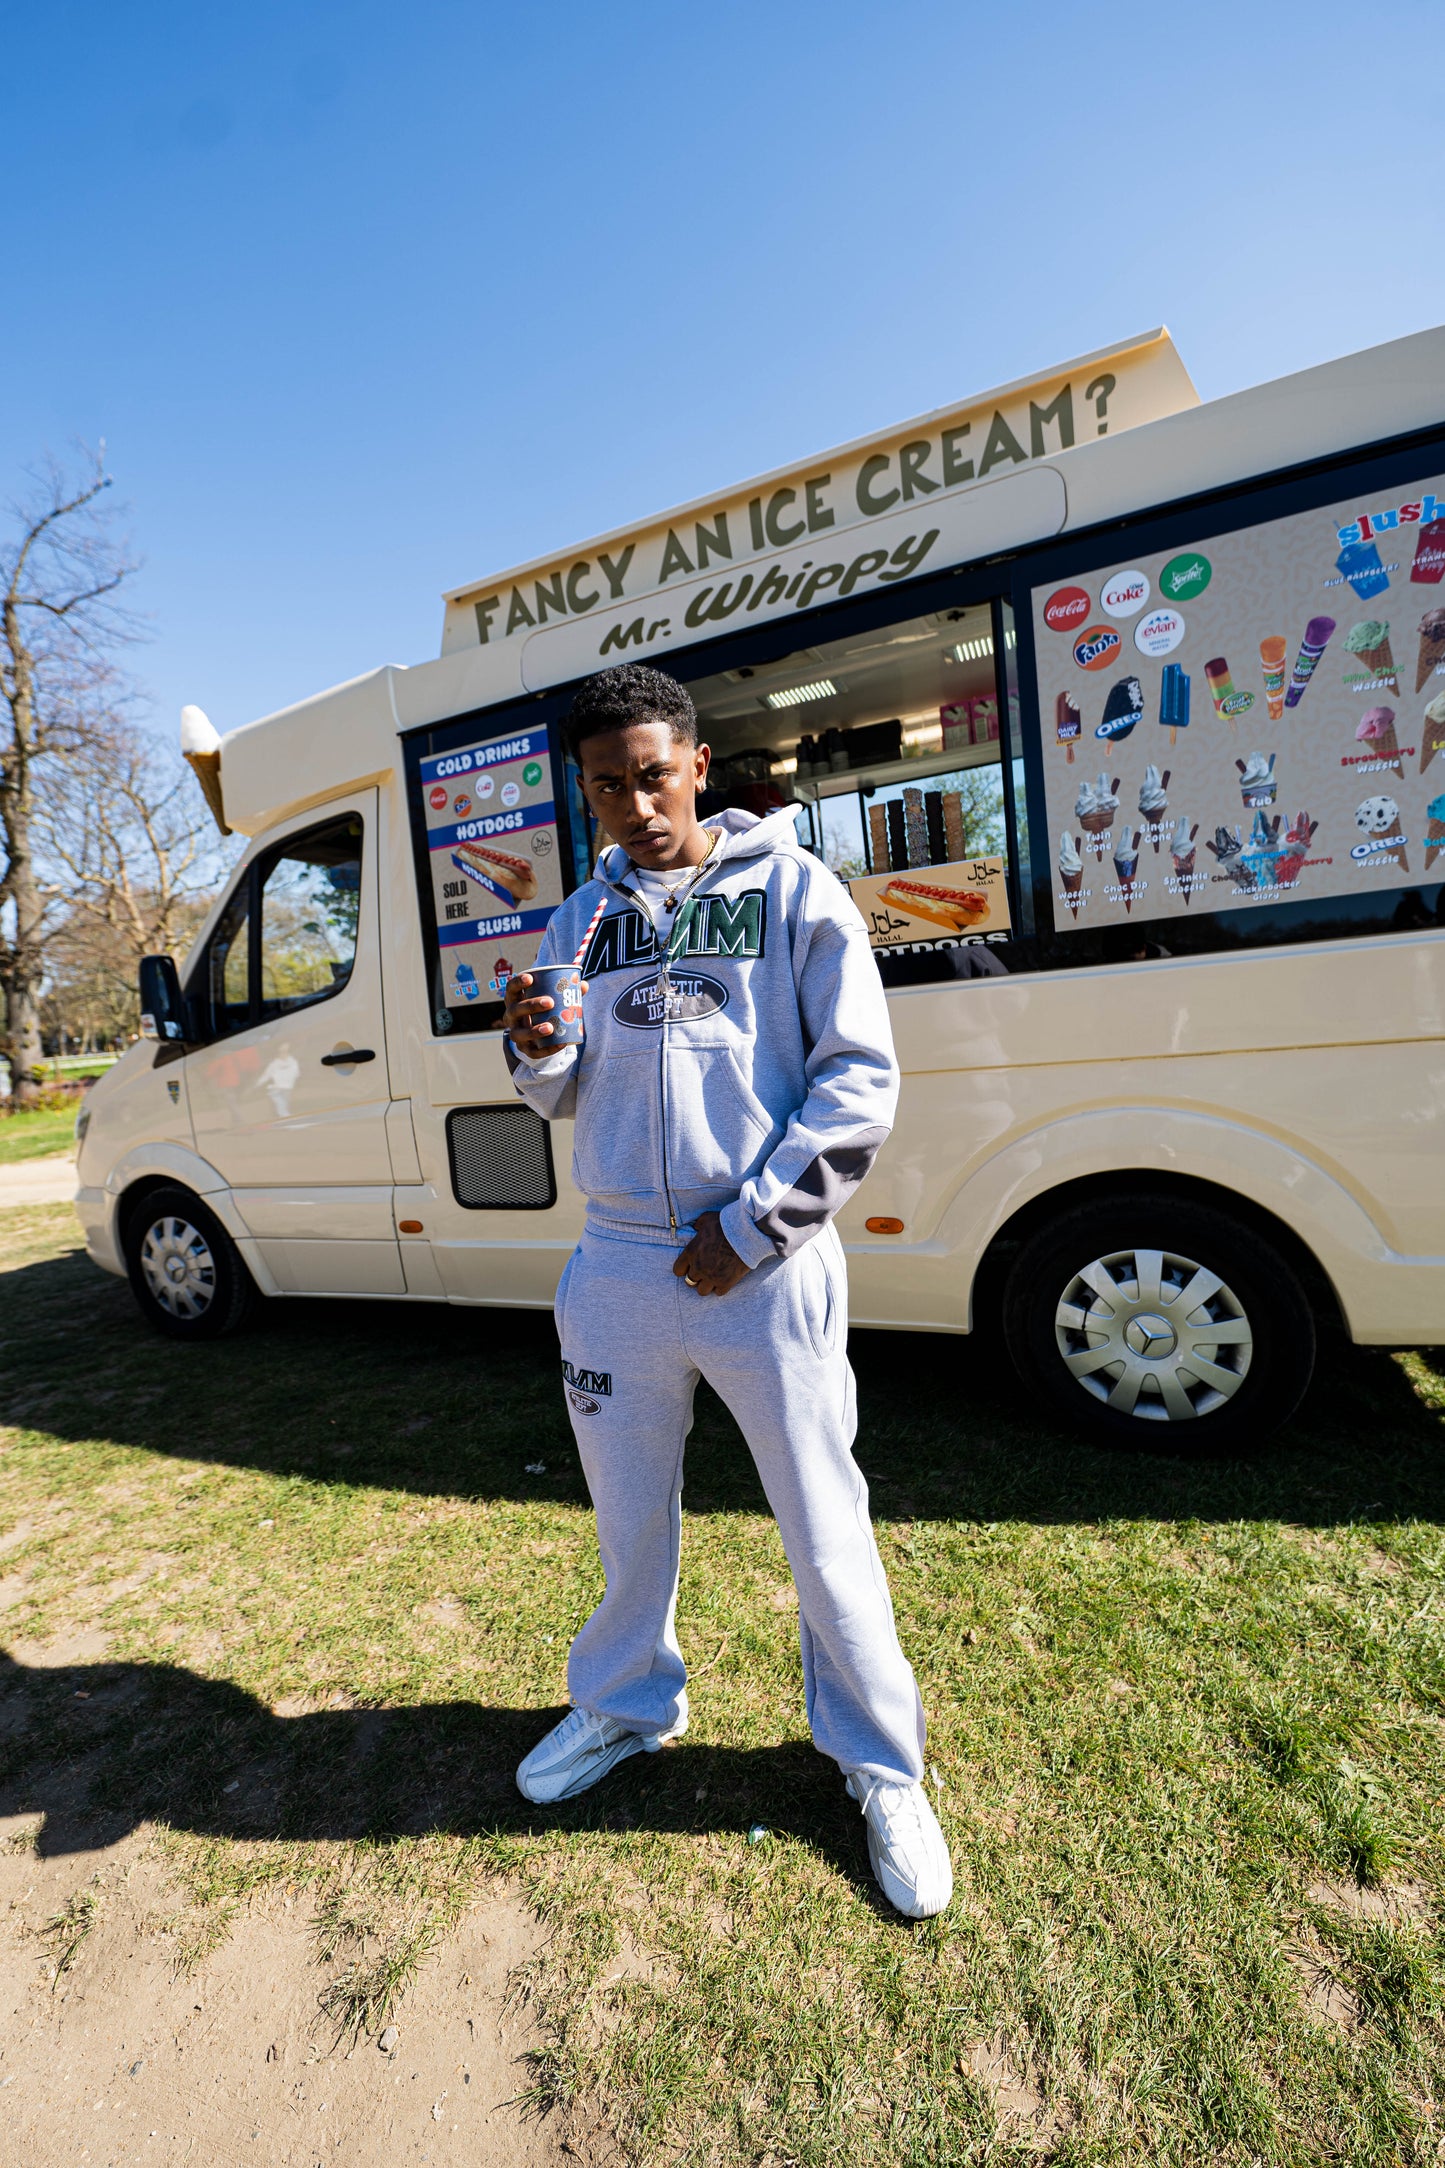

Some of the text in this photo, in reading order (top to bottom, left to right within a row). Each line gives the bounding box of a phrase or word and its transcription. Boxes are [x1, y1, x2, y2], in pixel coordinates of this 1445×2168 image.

[1337, 495, 1445, 548] slush
[474, 543, 636, 645] FANCY
[658, 511, 733, 585] AN
[748, 473, 836, 551] ICE
[599, 528, 941, 656] Mr. Whippy
[1106, 587, 1145, 606] Coke
[1143, 621, 1177, 638] evian
[1074, 633, 1119, 665] Fanta
[1352, 677, 1396, 692] Waffle
[1096, 711, 1142, 737] OREO
[436, 738, 531, 777] COLD DRINKS
[1341, 746, 1415, 767] Strawberry
[1356, 760, 1400, 773] Waffle
[1249, 795, 1273, 808] Tub
[456, 811, 524, 841] HOTDOGS
[1139, 819, 1176, 833] Single
[1085, 831, 1112, 842] Twin
[1144, 832, 1172, 844] Cone
[1086, 842, 1112, 853] Cone
[1351, 835, 1407, 859] OREO
[1356, 855, 1400, 867] Waffle
[461, 862, 495, 892] HOTDOGS
[976, 879, 995, 887] HALAL
[1163, 872, 1209, 886] Sprinkle
[443, 880, 468, 899] SOLD
[1103, 880, 1148, 893] Choc Dip
[1168, 883, 1205, 894] Waffle
[1231, 881, 1301, 895] Knickerbocker
[1058, 889, 1092, 900] Waffle
[1109, 892, 1144, 902] Waffle
[1253, 892, 1280, 901] Glory
[445, 901, 470, 920] HERE
[1064, 899, 1087, 908] Cone
[477, 915, 522, 937] SLUSH
[876, 934, 904, 943] HALAL
[630, 980, 703, 1006] ATHETIC
[647, 997, 684, 1021] DEPT
